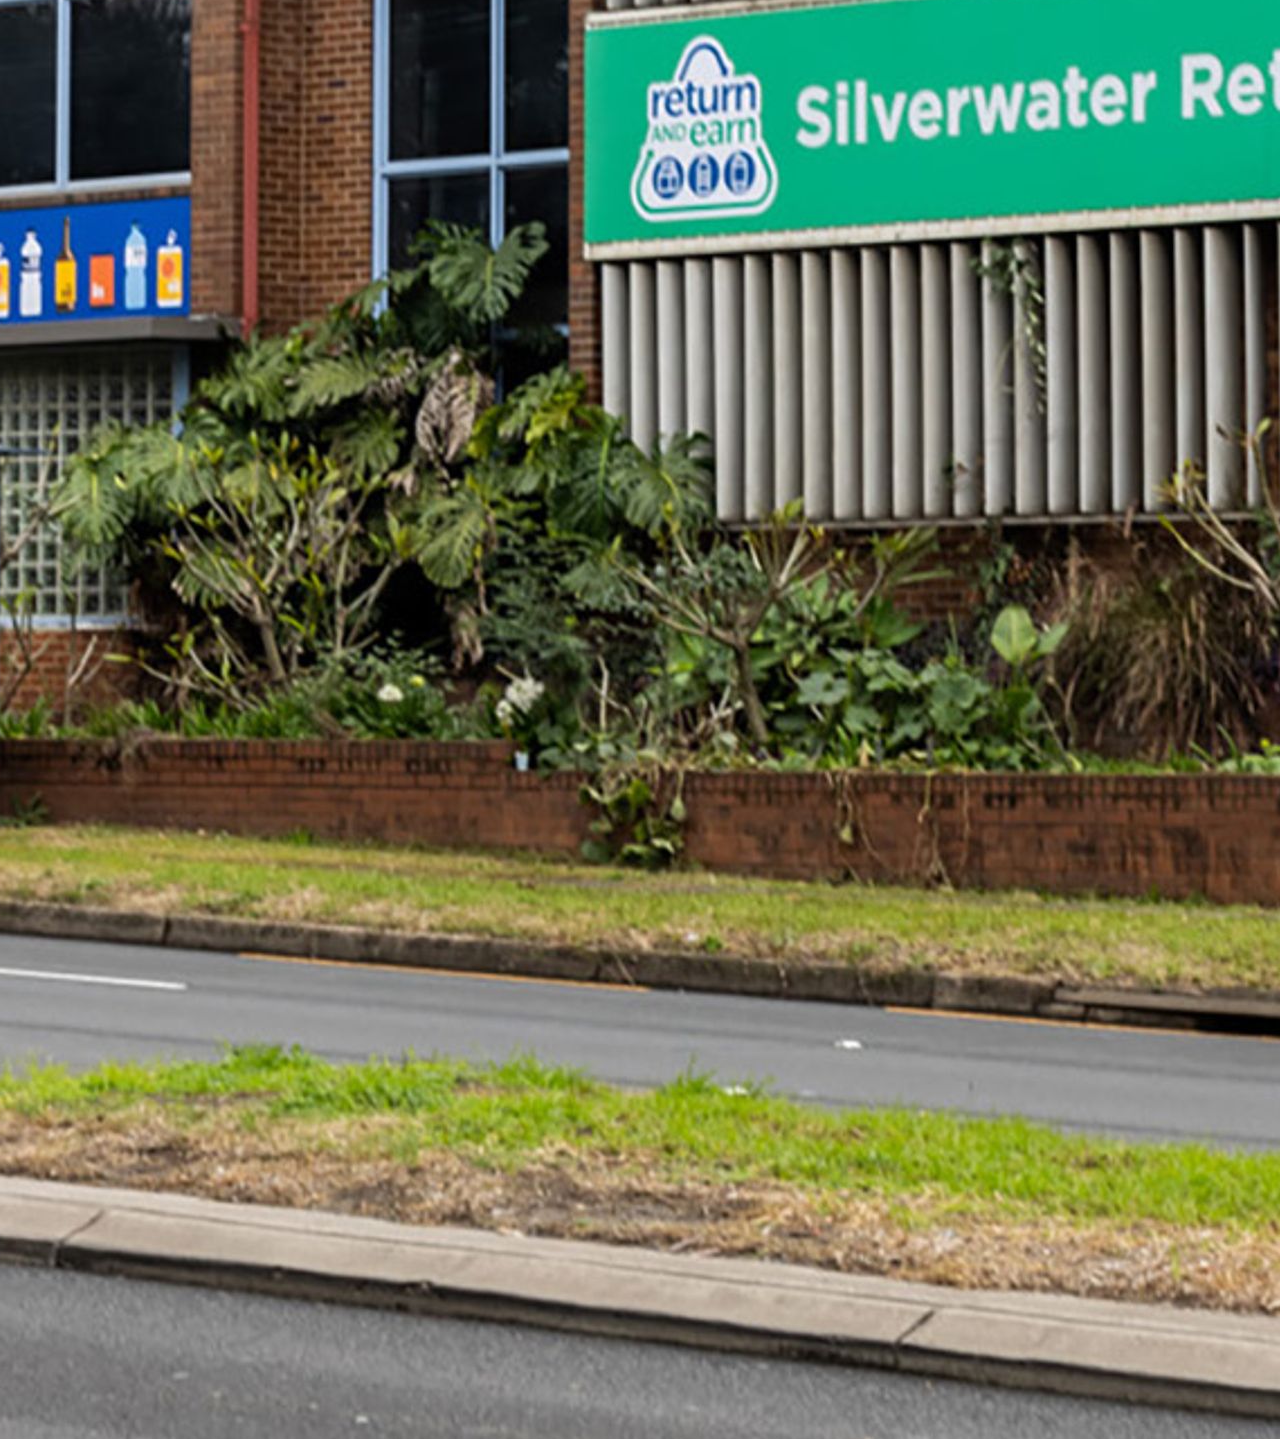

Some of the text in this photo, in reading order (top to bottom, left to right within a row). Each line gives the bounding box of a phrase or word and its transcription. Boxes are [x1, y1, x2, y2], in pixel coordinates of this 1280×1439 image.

[651, 80, 756, 119] return
[796, 66, 1157, 149] Silverwater
[652, 118, 756, 147] AND earn
